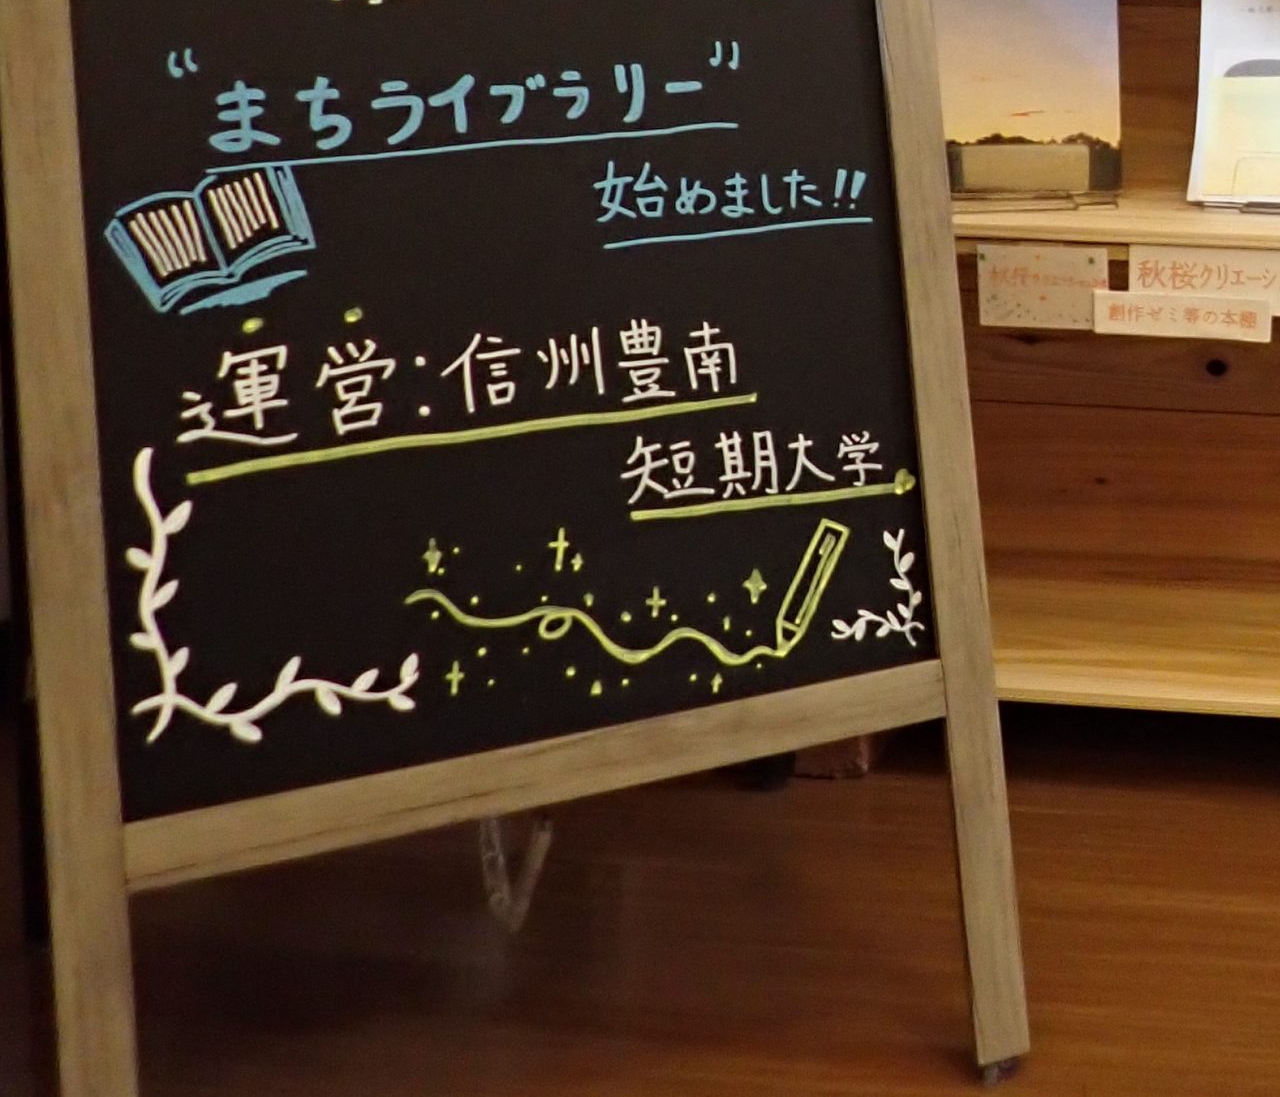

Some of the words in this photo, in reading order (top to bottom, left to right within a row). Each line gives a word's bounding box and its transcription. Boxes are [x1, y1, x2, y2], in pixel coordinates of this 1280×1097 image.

[1108, 302, 1258, 330] 創作ゼミ等の本棚
[619, 430, 884, 504] 短期大学
